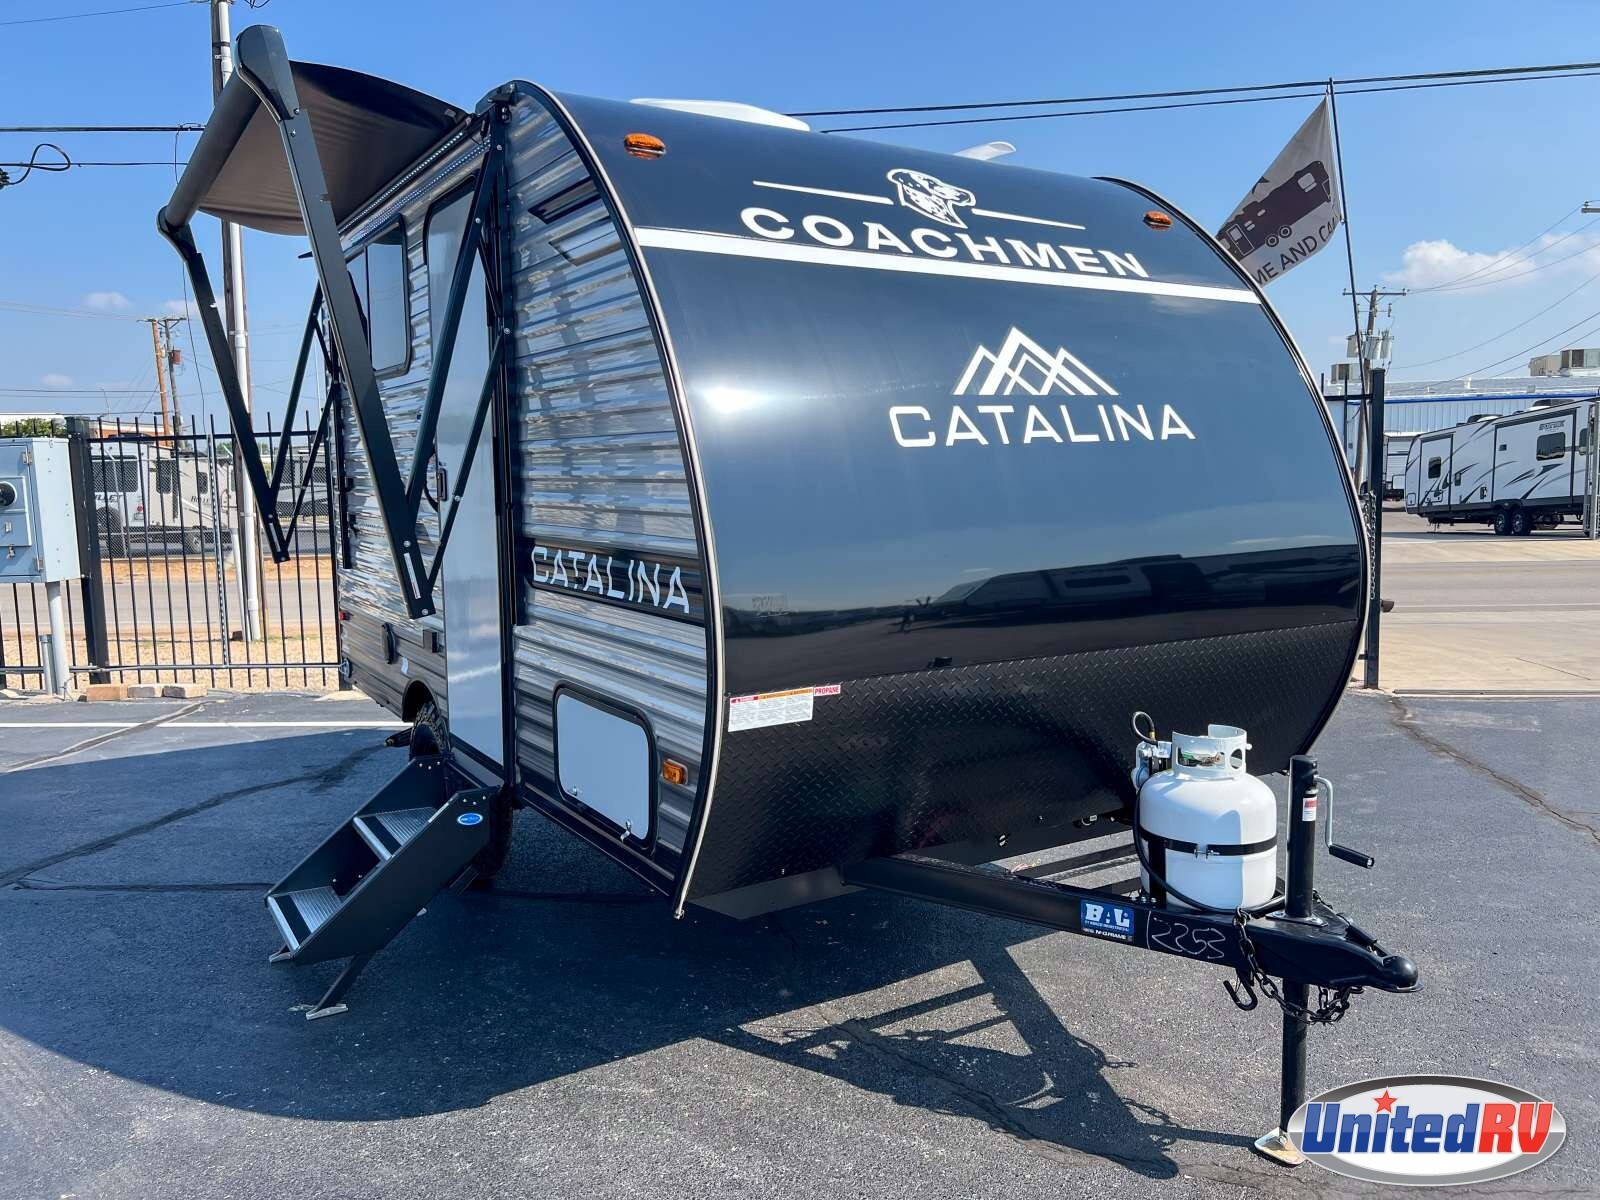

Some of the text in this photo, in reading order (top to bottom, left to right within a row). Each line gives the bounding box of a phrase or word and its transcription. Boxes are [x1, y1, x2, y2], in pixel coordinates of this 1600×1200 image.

[740, 207, 1149, 279] COACHMEN
[1279, 235, 1318, 271] AND
[888, 402, 1197, 448] CATALINA
[531, 545, 690, 614] CATALINA
[814, 685, 840, 695] PROPANE
[1085, 903, 1130, 928] BAL
